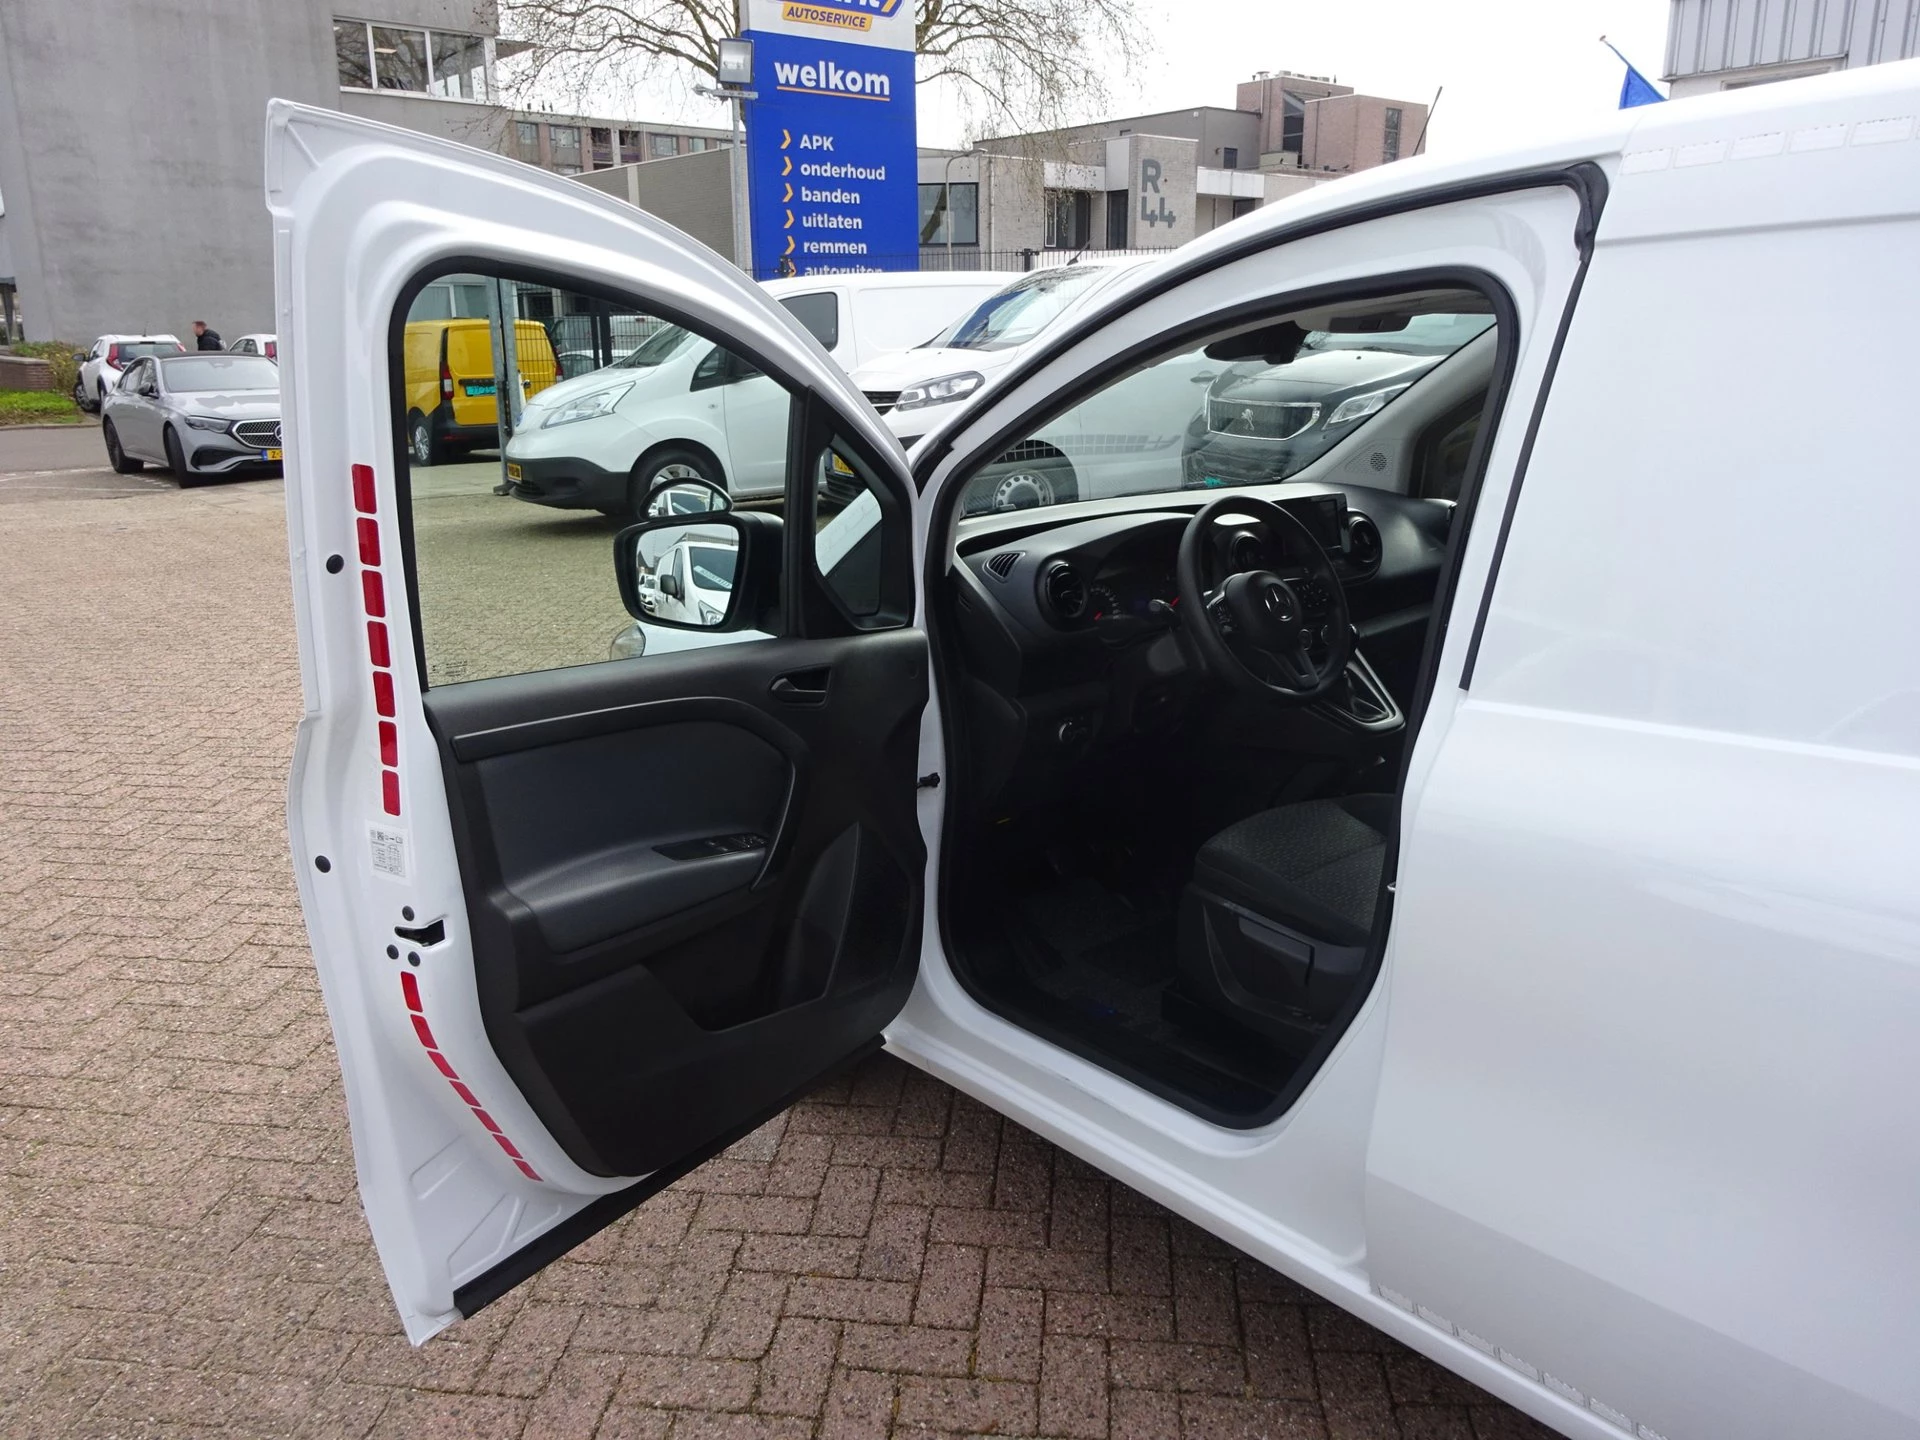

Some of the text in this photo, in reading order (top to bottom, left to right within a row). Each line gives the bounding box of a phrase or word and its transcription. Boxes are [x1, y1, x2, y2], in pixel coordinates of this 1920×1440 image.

[787, 6, 867, 27] AUTOSERVICE
[774, 60, 890, 95] welkom
[800, 134, 834, 151] APK
[800, 162, 886, 181] onderhoud
[801, 187, 861, 204] banden
[802, 213, 863, 230] uitlaten
[1141, 196, 1176, 229] 44
[803, 241, 868, 255] remmen
